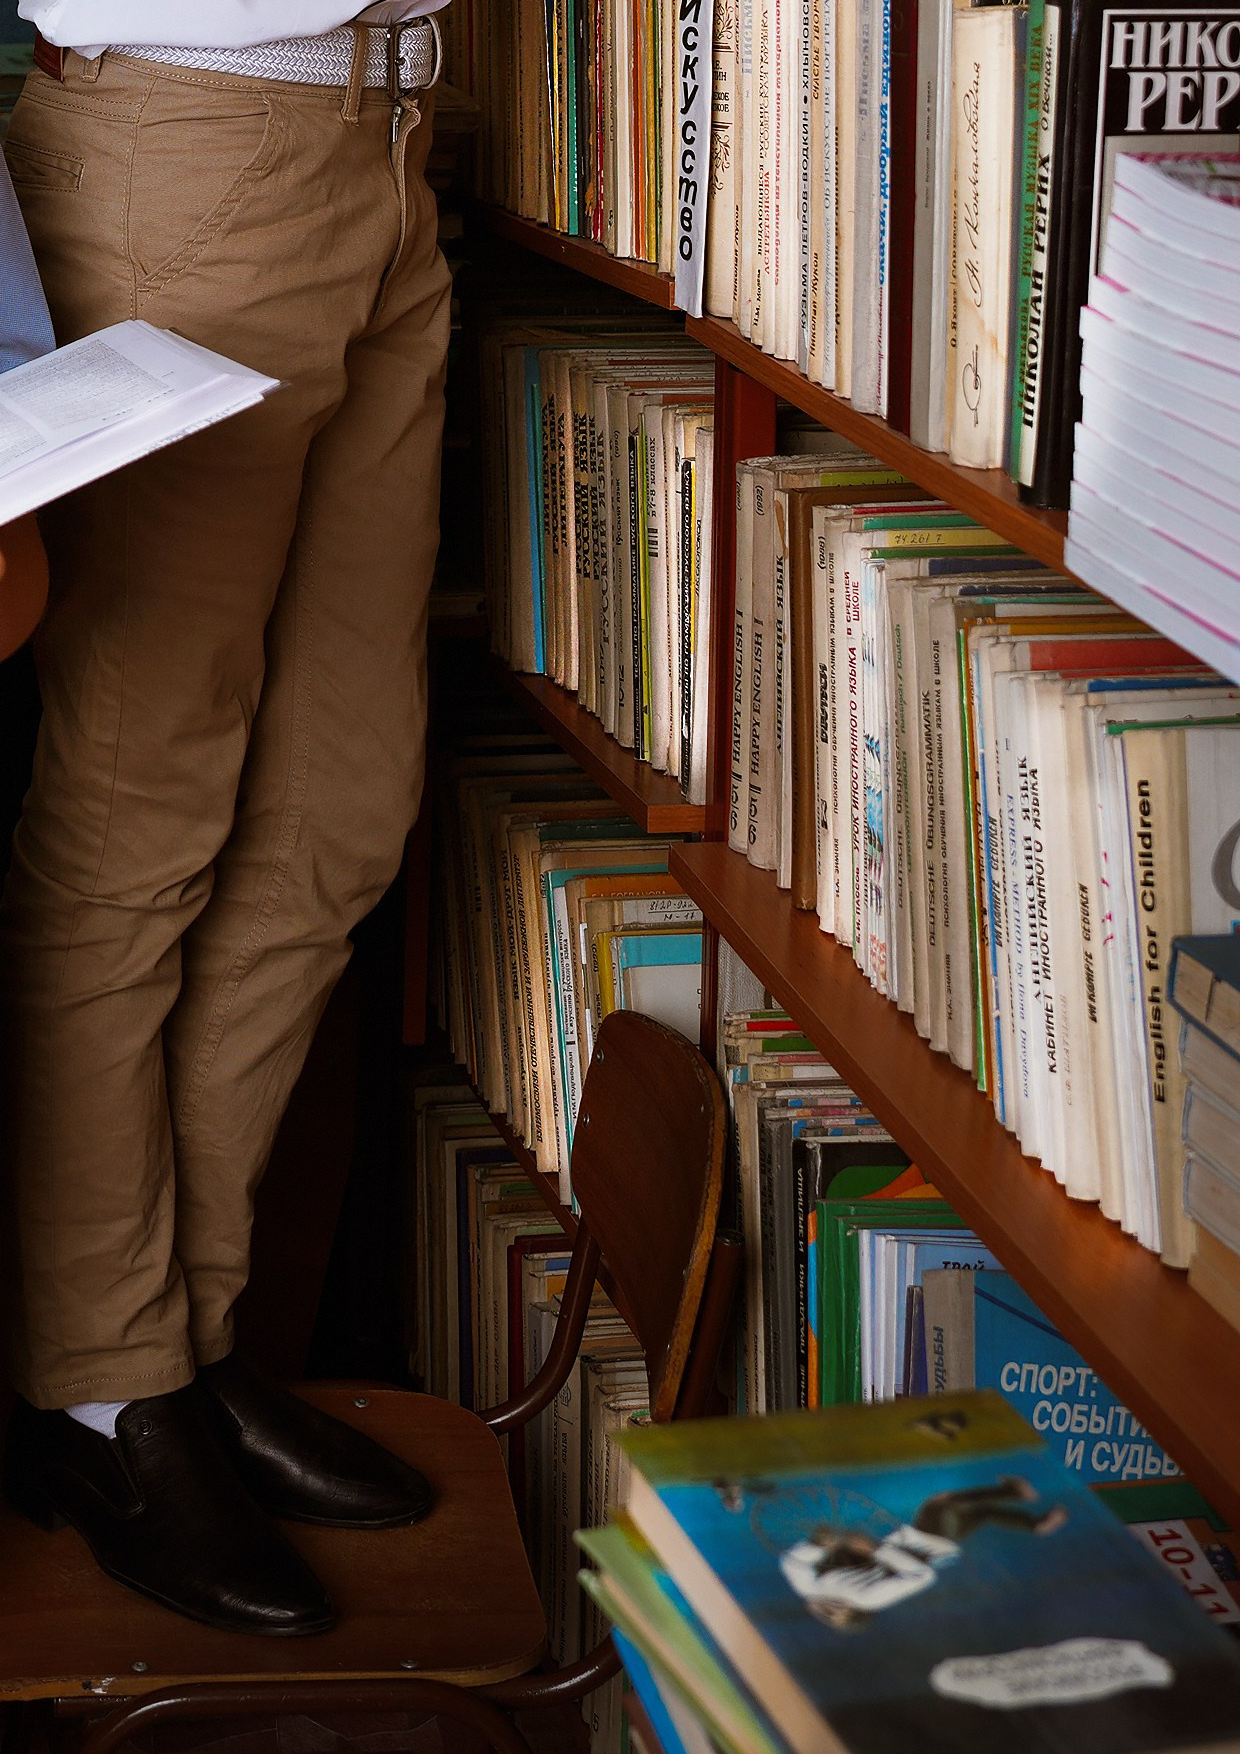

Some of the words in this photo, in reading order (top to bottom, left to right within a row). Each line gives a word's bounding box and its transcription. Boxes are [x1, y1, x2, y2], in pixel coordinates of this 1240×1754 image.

[812, 47, 820, 100] СЧАСТЬЕ
[801, 111, 809, 255] ПЕТРОВ-ВОДКИН
[879, 103, 890, 199] добрый
[800, 263, 808, 329] КУЗЬМА
[811, 252, 819, 296] Жуков
[1023, 271, 1044, 429] НИКОЛАЙ
[1034, 154, 1050, 254] РЕРИХ
[809, 300, 817, 356] Николай
[578, 413, 588, 472] ЯЗЫК
[580, 482, 591, 578] РУССКИЙ
[775, 556, 783, 609] ЯЗЫК
[851, 581, 860, 622] ШКОЛЕ
[734, 622, 743, 705] ENGLISH
[751, 632, 763, 714] ENGLISH
[847, 647, 857, 696] ЯЗЫКА
[732, 706, 742, 764] HAPPY
[750, 719, 761, 776] HAPPY
[849, 701, 859, 810] ИНОСТРАННОГО
[922, 690, 935, 849] ÜBUNGSGRAMMATIK
[1017, 755, 1030, 821] ЯЗЫК
[1029, 767, 1042, 830] ЯЗЫКА
[852, 816, 860, 852] УРОК
[1137, 778, 1155, 912] Children
[926, 860, 936, 946] DEUTSCHE
[1033, 840, 1051, 981] ИНОСТРАННОГО
[518, 907, 530, 972] ЗАРУБЕЖНОЙ
[1146, 925, 1160, 971] for
[525, 987, 537, 1067] ОТЕЧЕСТВЕННОЙ
[1044, 992, 1057, 1074] КАБИНЕТ
[1150, 986, 1166, 1103] English
[531, 1070, 542, 1143] ВЗАИМОСВЯЗИ
[798, 1264, 806, 1353] ПРАЗДНИКИ
[1000, 1361, 1099, 1397] СПОРТ:
[1031, 1399, 1153, 1438] СОБЫТИ
[1063, 1439, 1083, 1470] И
[1090, 1440, 1185, 1480] СУДЬБ
[1147, 1526, 1230, 1617] 10-11
